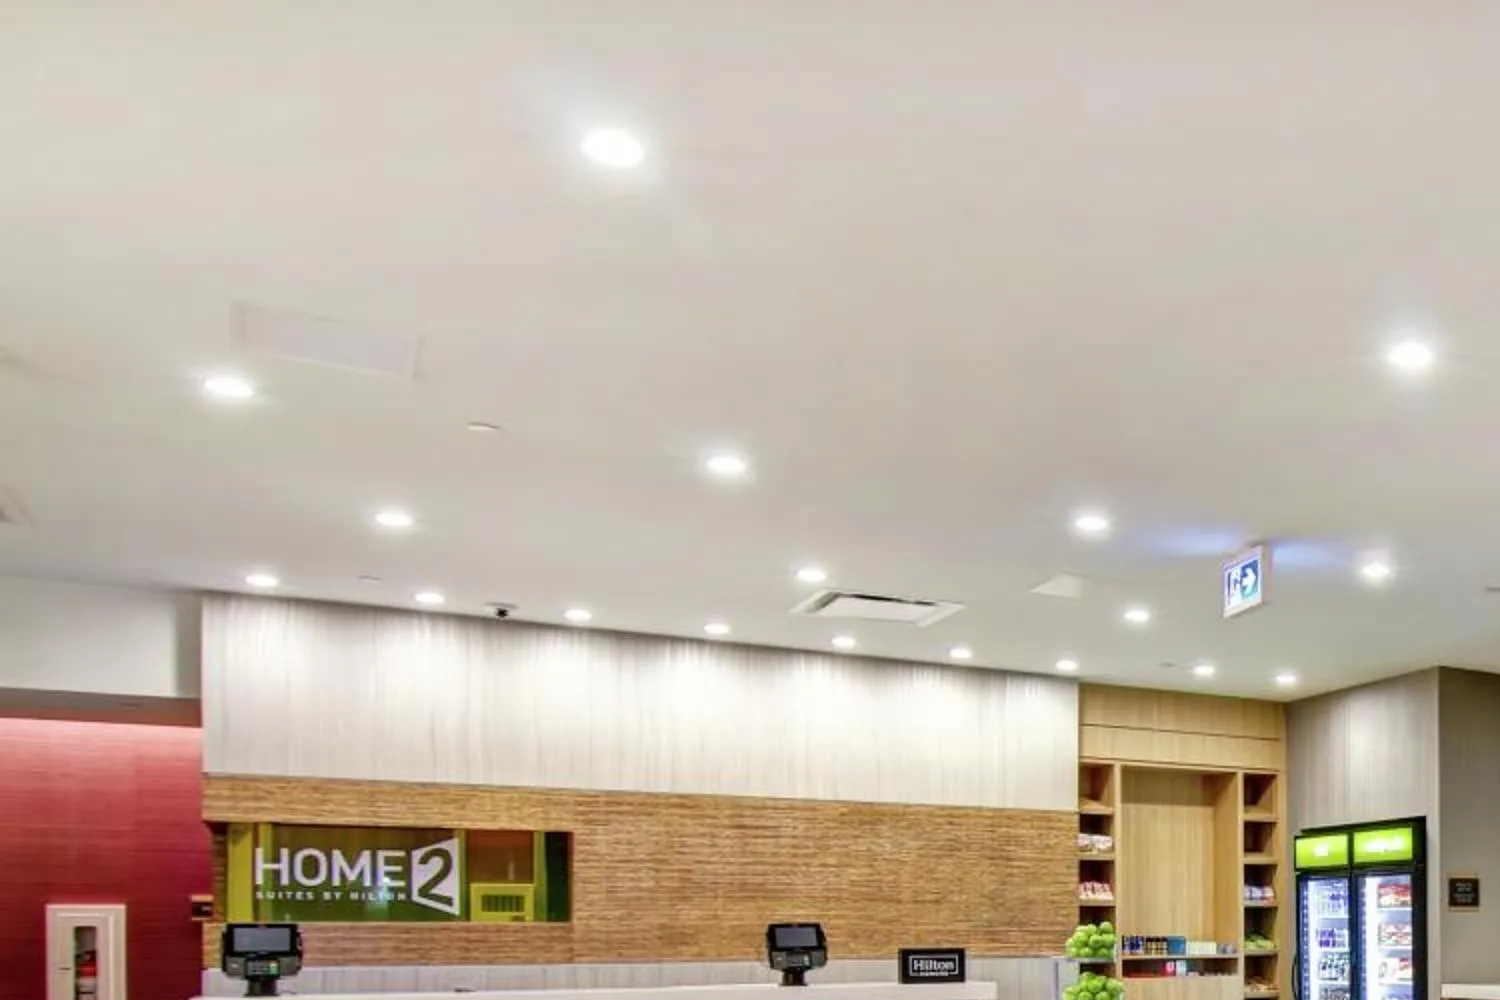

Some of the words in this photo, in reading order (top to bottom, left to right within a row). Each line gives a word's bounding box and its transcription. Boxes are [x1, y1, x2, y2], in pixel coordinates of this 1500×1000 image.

[255, 837, 460, 916] HOME2
[255, 891, 314, 901] SUITES
[323, 891, 342, 901] BY
[913, 959, 955, 971] Hilton
